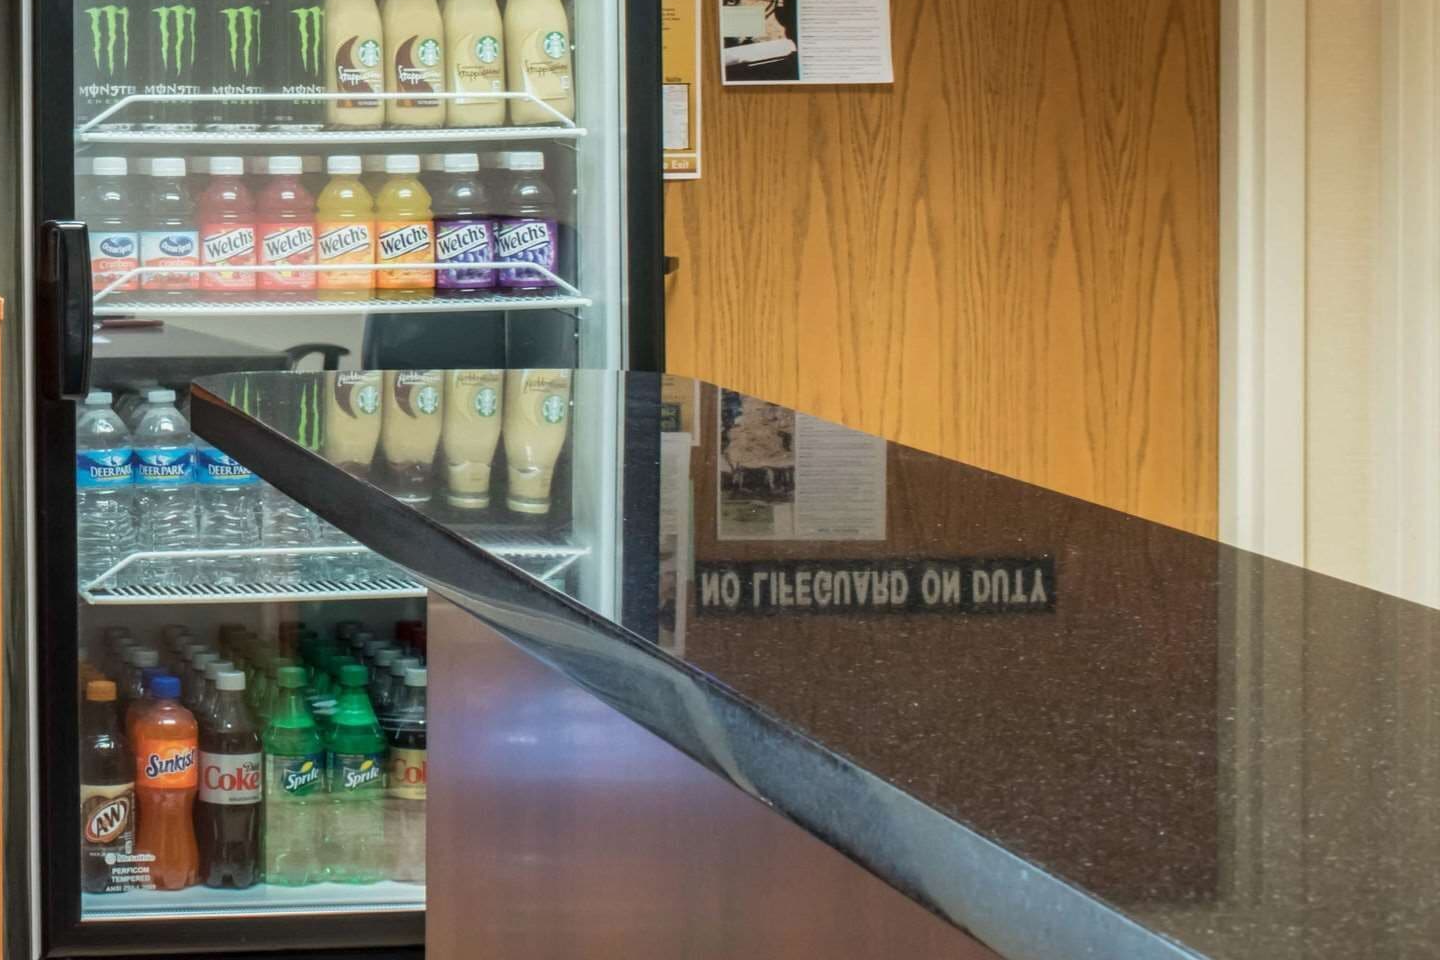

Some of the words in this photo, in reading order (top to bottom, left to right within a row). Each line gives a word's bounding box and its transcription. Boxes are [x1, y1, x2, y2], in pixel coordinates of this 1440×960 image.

[206, 228, 253, 258] Welch's
[265, 227, 313, 257] Welch's
[320, 226, 368, 256] Welch's
[380, 225, 428, 255] Welch's
[438, 225, 486, 255] Welch's
[498, 223, 547, 253] Welch's
[90, 465, 116, 478] DEER
[139, 464, 161, 477] DEER
[161, 464, 185, 476] PARK
[208, 464, 231, 477] DEER
[145, 748, 194, 778] Sunkist
[205, 765, 260, 791] Coke
[285, 766, 320, 790] Sprite
[343, 766, 380, 789] Sprite
